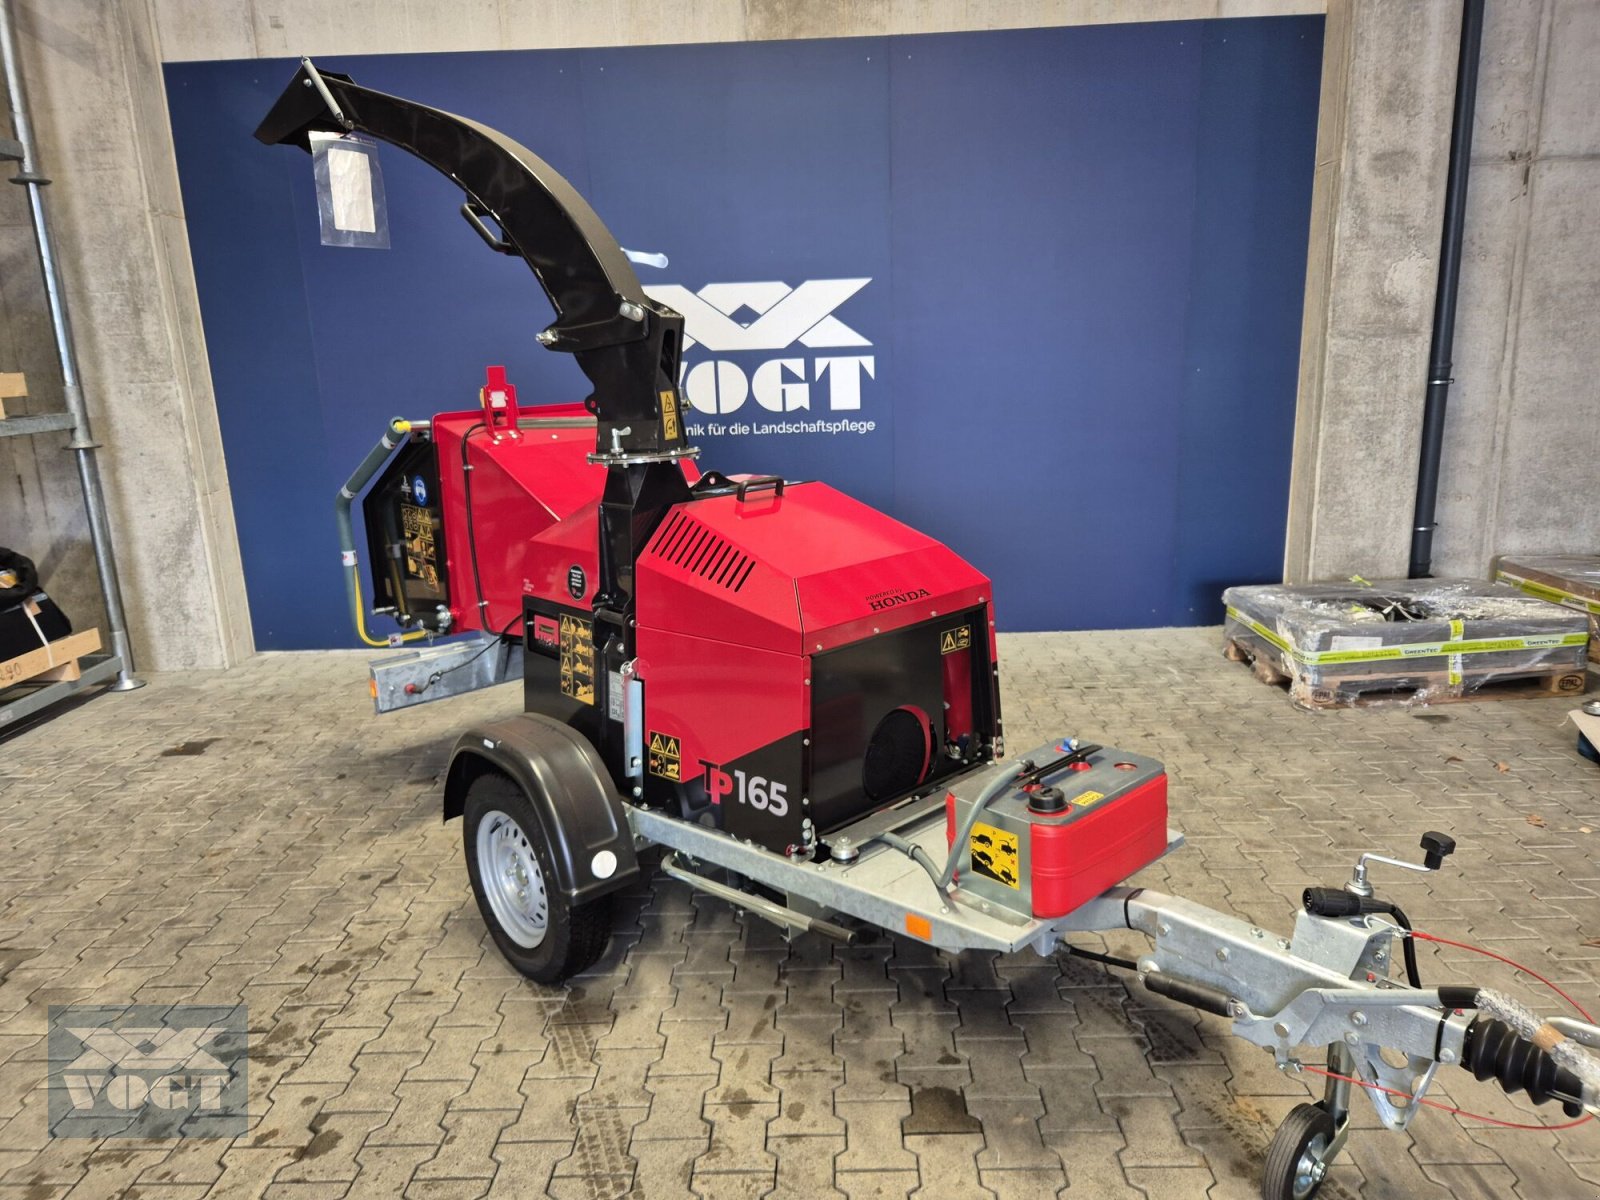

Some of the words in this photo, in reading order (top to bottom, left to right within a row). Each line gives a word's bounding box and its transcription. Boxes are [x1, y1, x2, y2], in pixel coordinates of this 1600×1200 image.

[679, 356, 875, 414] OGT
[685, 424, 705, 436] nik
[708, 422, 726, 436] für
[730, 421, 750, 435] die
[753, 419, 876, 435] Landschaftspflege
[871, 589, 930, 611] HONDA
